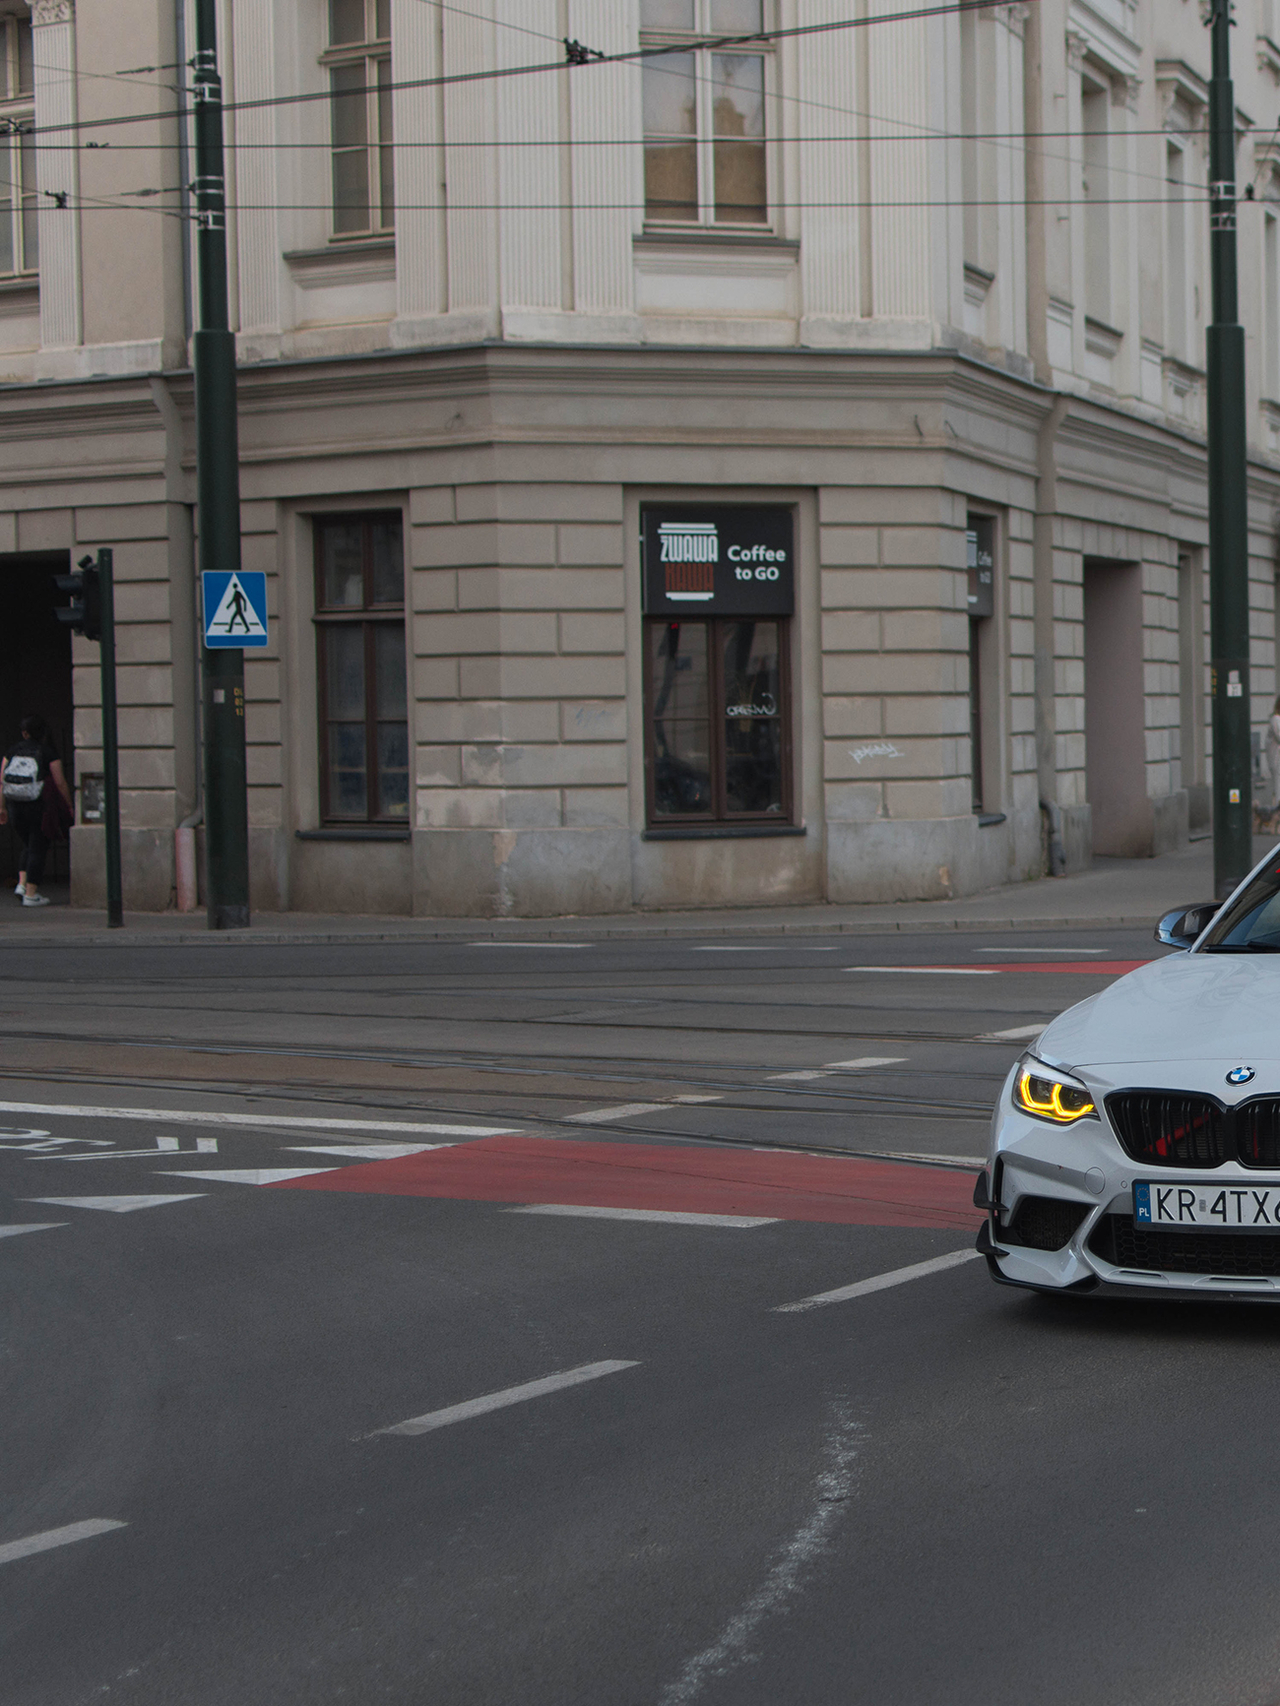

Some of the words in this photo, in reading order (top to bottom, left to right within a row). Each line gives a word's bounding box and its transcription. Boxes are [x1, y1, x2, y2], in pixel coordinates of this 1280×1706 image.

[660, 535, 719, 563] ŻWAWA
[727, 545, 787, 562] Coffee
[665, 563, 714, 591] KAWA
[734, 566, 751, 581] to
[754, 566, 780, 581] GO
[1138, 1207, 1150, 1217] PL
[1156, 1187, 1197, 1222] KR
